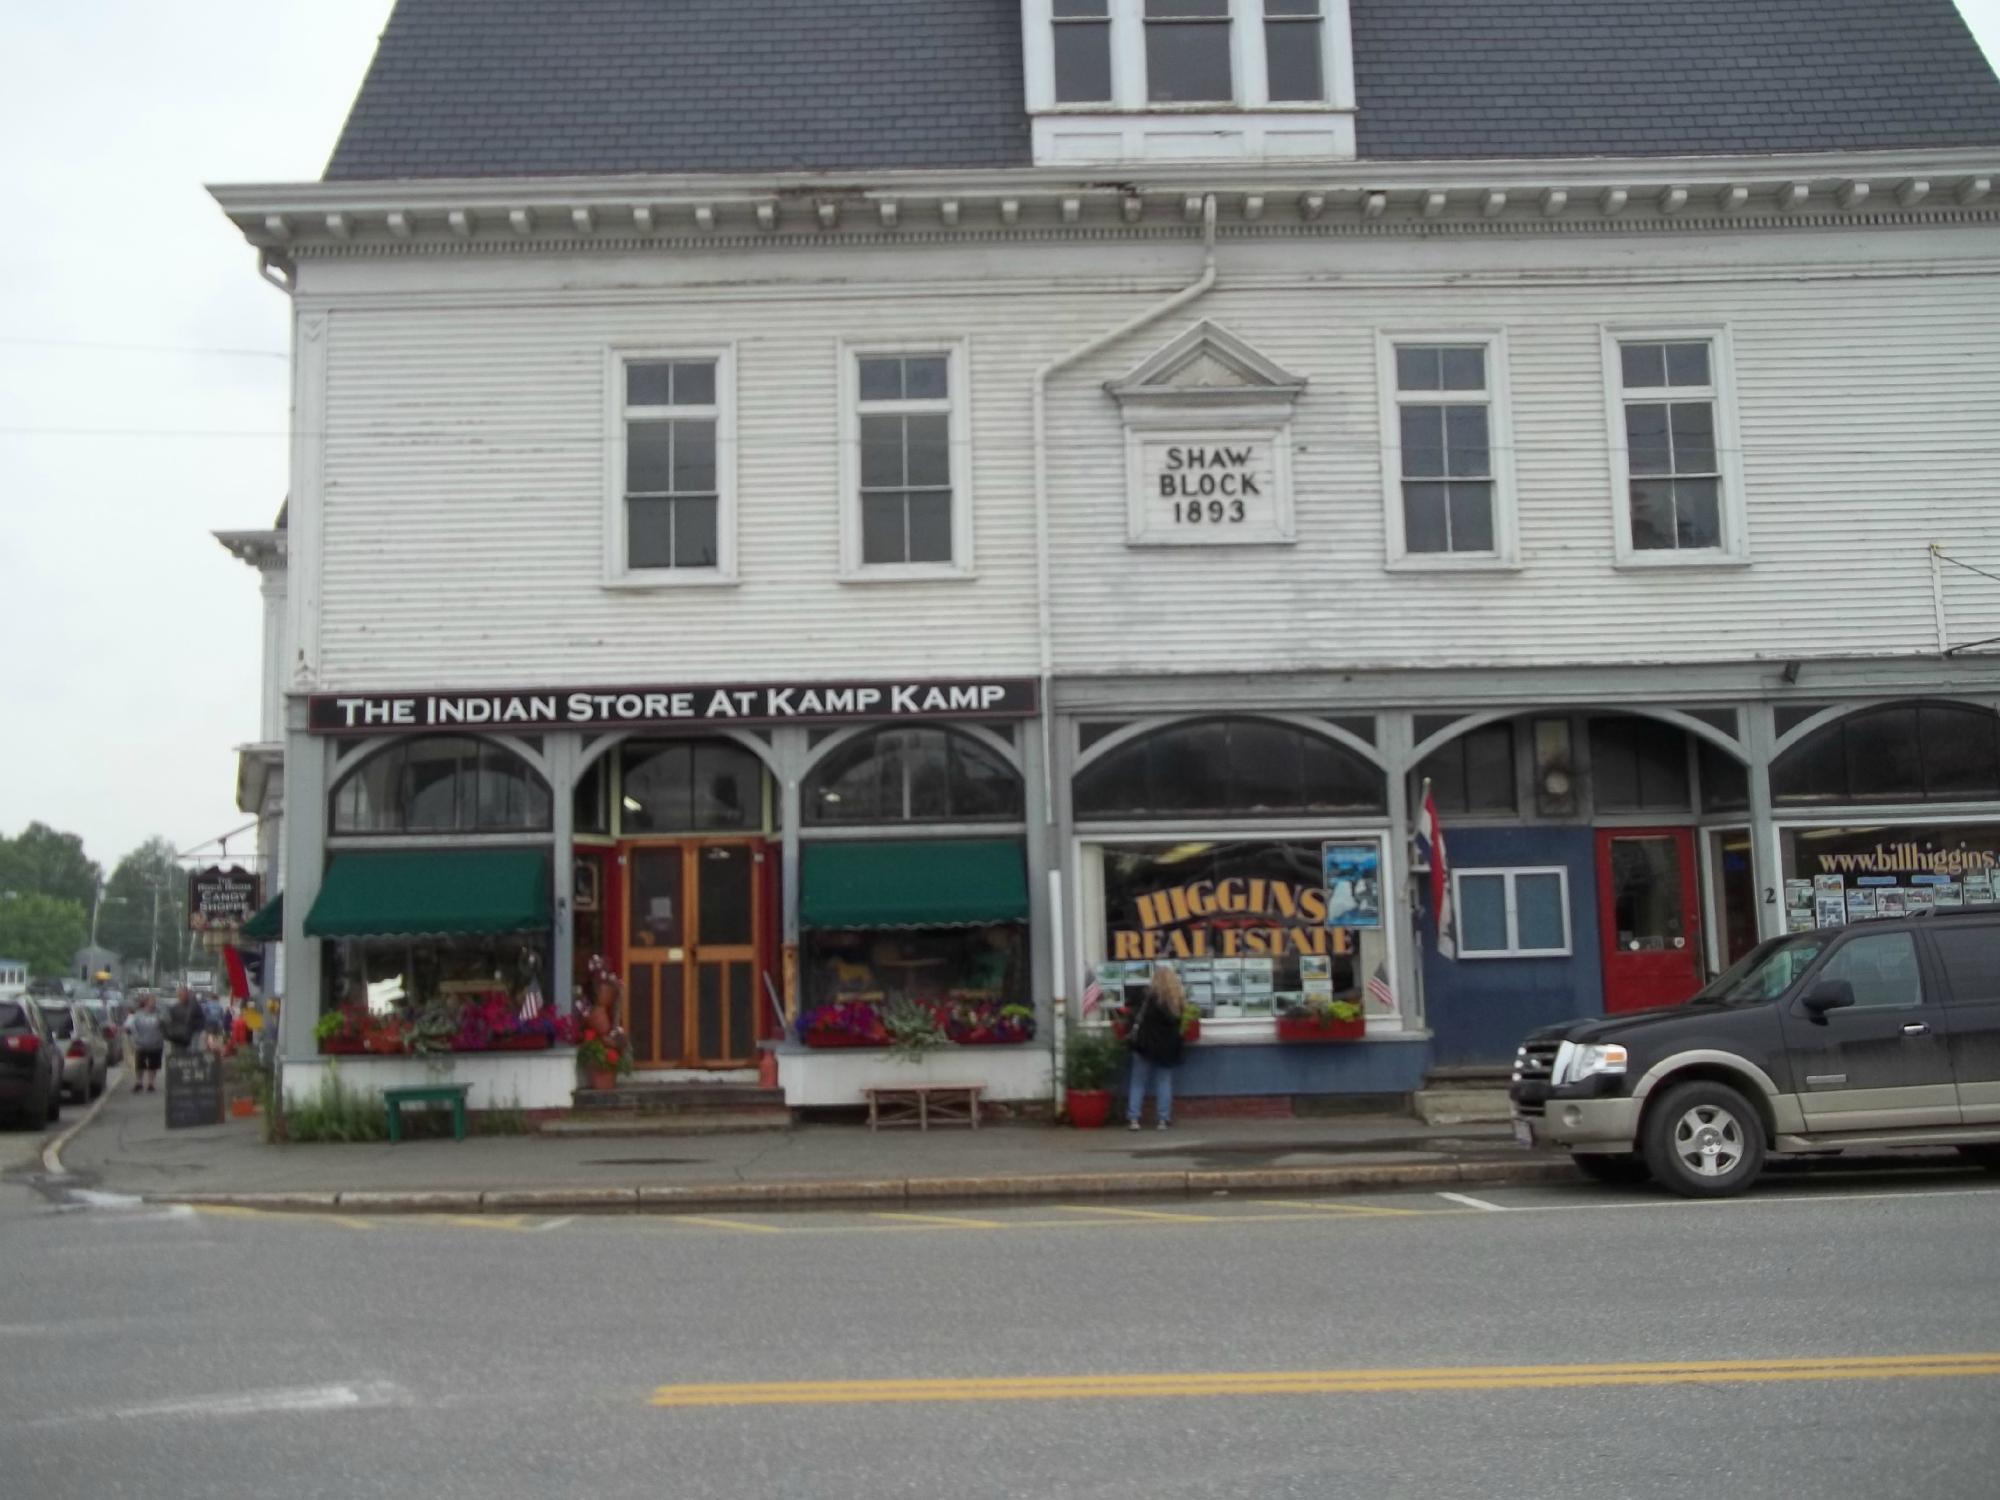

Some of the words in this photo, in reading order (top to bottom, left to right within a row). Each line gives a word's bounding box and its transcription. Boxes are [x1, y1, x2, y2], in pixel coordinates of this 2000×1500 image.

[1166, 447, 1252, 470] SHAW
[1160, 473, 1260, 497] BLOCK
[1175, 500, 1245, 524] 1893
[337, 697, 415, 727] THE
[427, 695, 556, 725] INDIAN
[567, 692, 694, 721] STORE
[705, 689, 757, 718] AT
[766, 687, 881, 716] KAMP
[891, 684, 1005, 713] KAMP
[1818, 841, 2000, 874] www.billhiggins.
[1135, 877, 1331, 929] HIGGINS
[1765, 887, 1776, 904] 2
[1114, 929, 1214, 960] REAL
[1223, 925, 1356, 957] ESTATE
